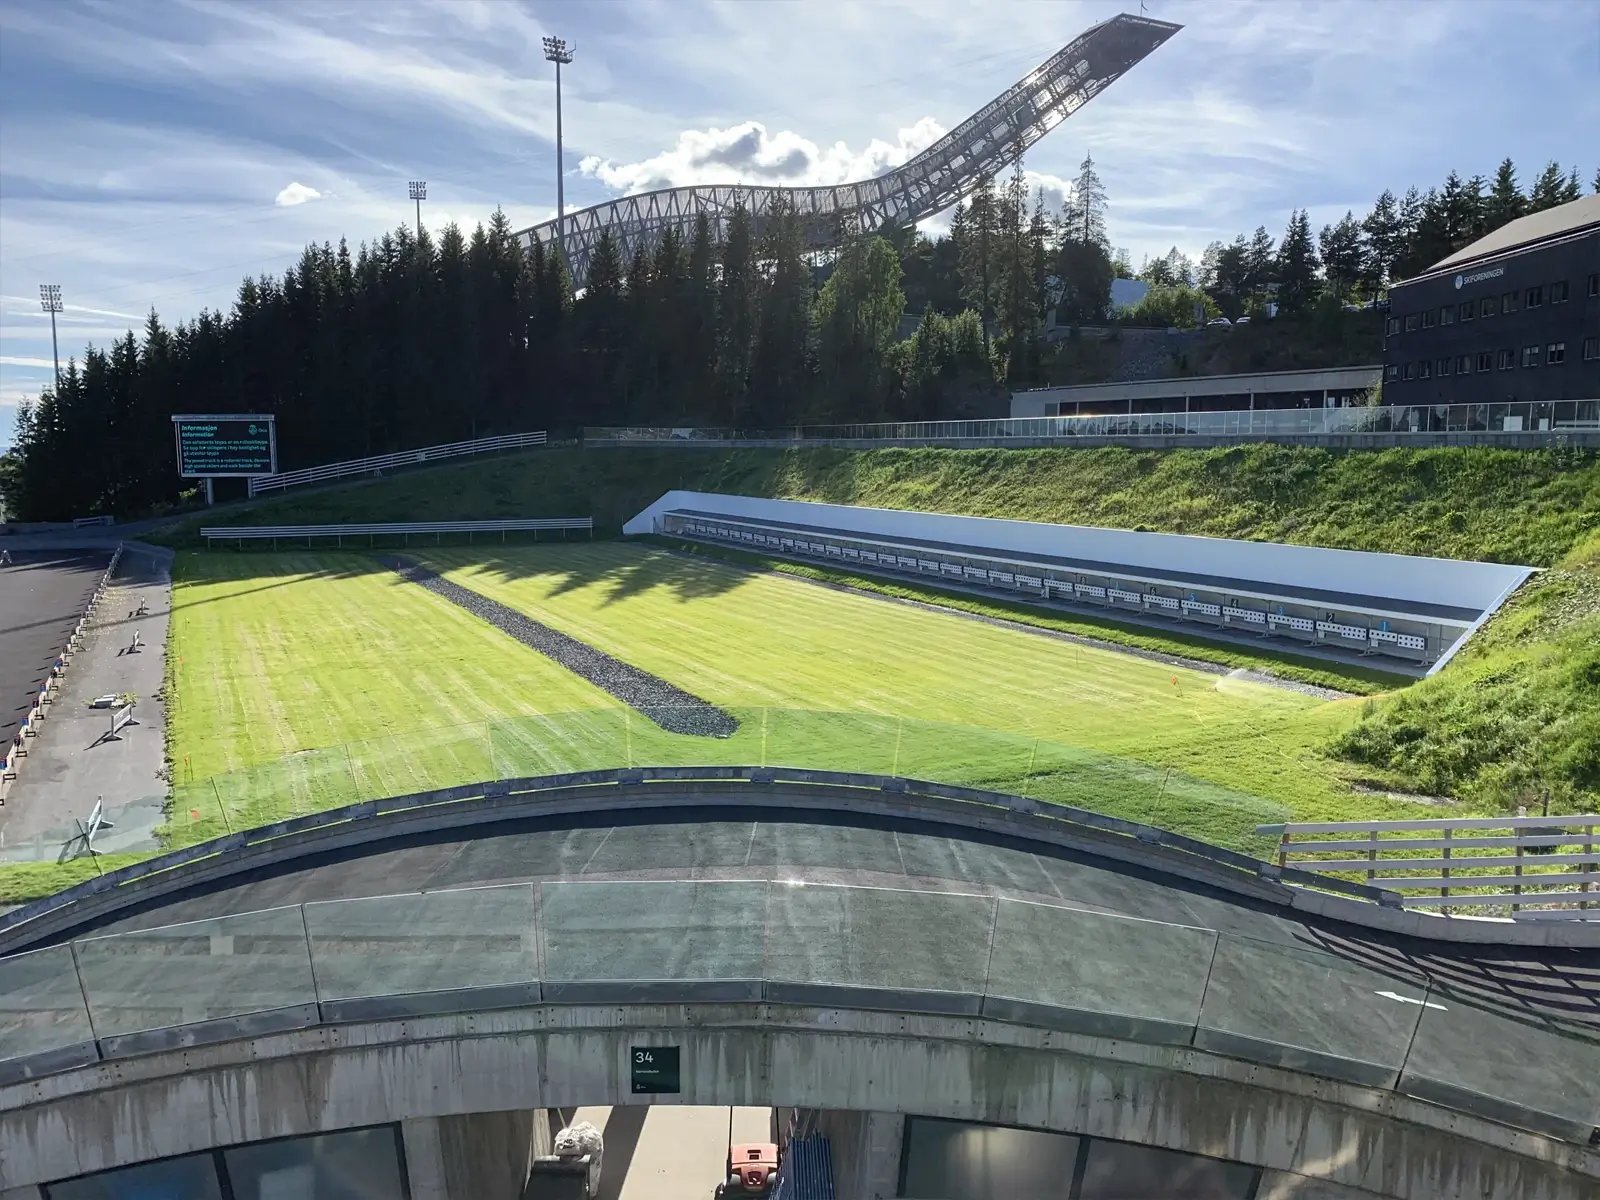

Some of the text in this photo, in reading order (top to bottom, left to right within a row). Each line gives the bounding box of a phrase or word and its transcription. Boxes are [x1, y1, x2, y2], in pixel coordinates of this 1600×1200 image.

[1464, 268, 1504, 284] SKIFORENINGEN
[1327, 612, 1333, 622] 2
[636, 1052, 653, 1063] 34
